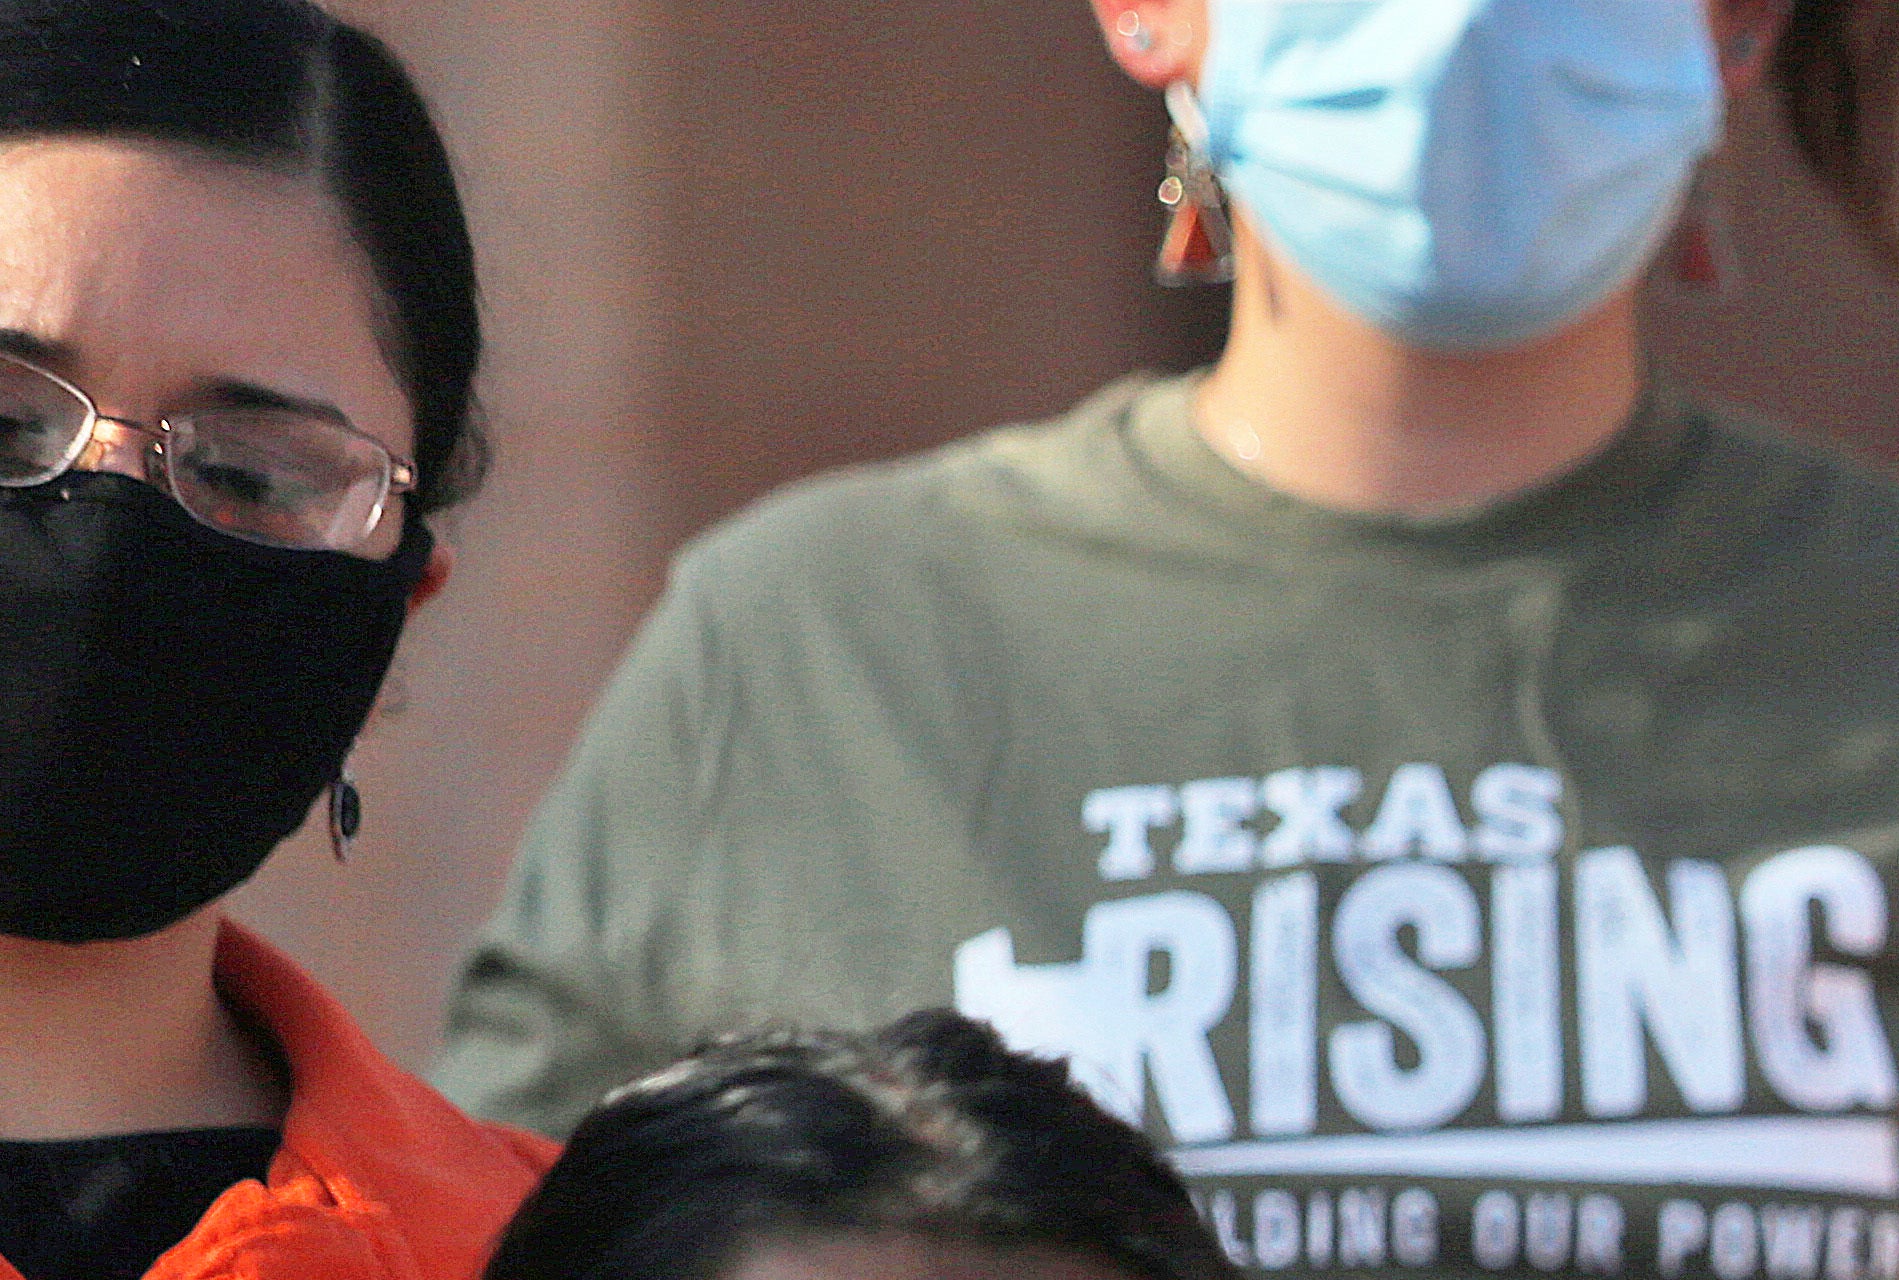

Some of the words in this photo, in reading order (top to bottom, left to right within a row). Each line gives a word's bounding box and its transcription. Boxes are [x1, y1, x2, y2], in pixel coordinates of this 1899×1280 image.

[1081, 762, 1564, 880] TEXAS
[1195, 1186, 1441, 1272] LDING
[1471, 1188, 1627, 1274] OUR
